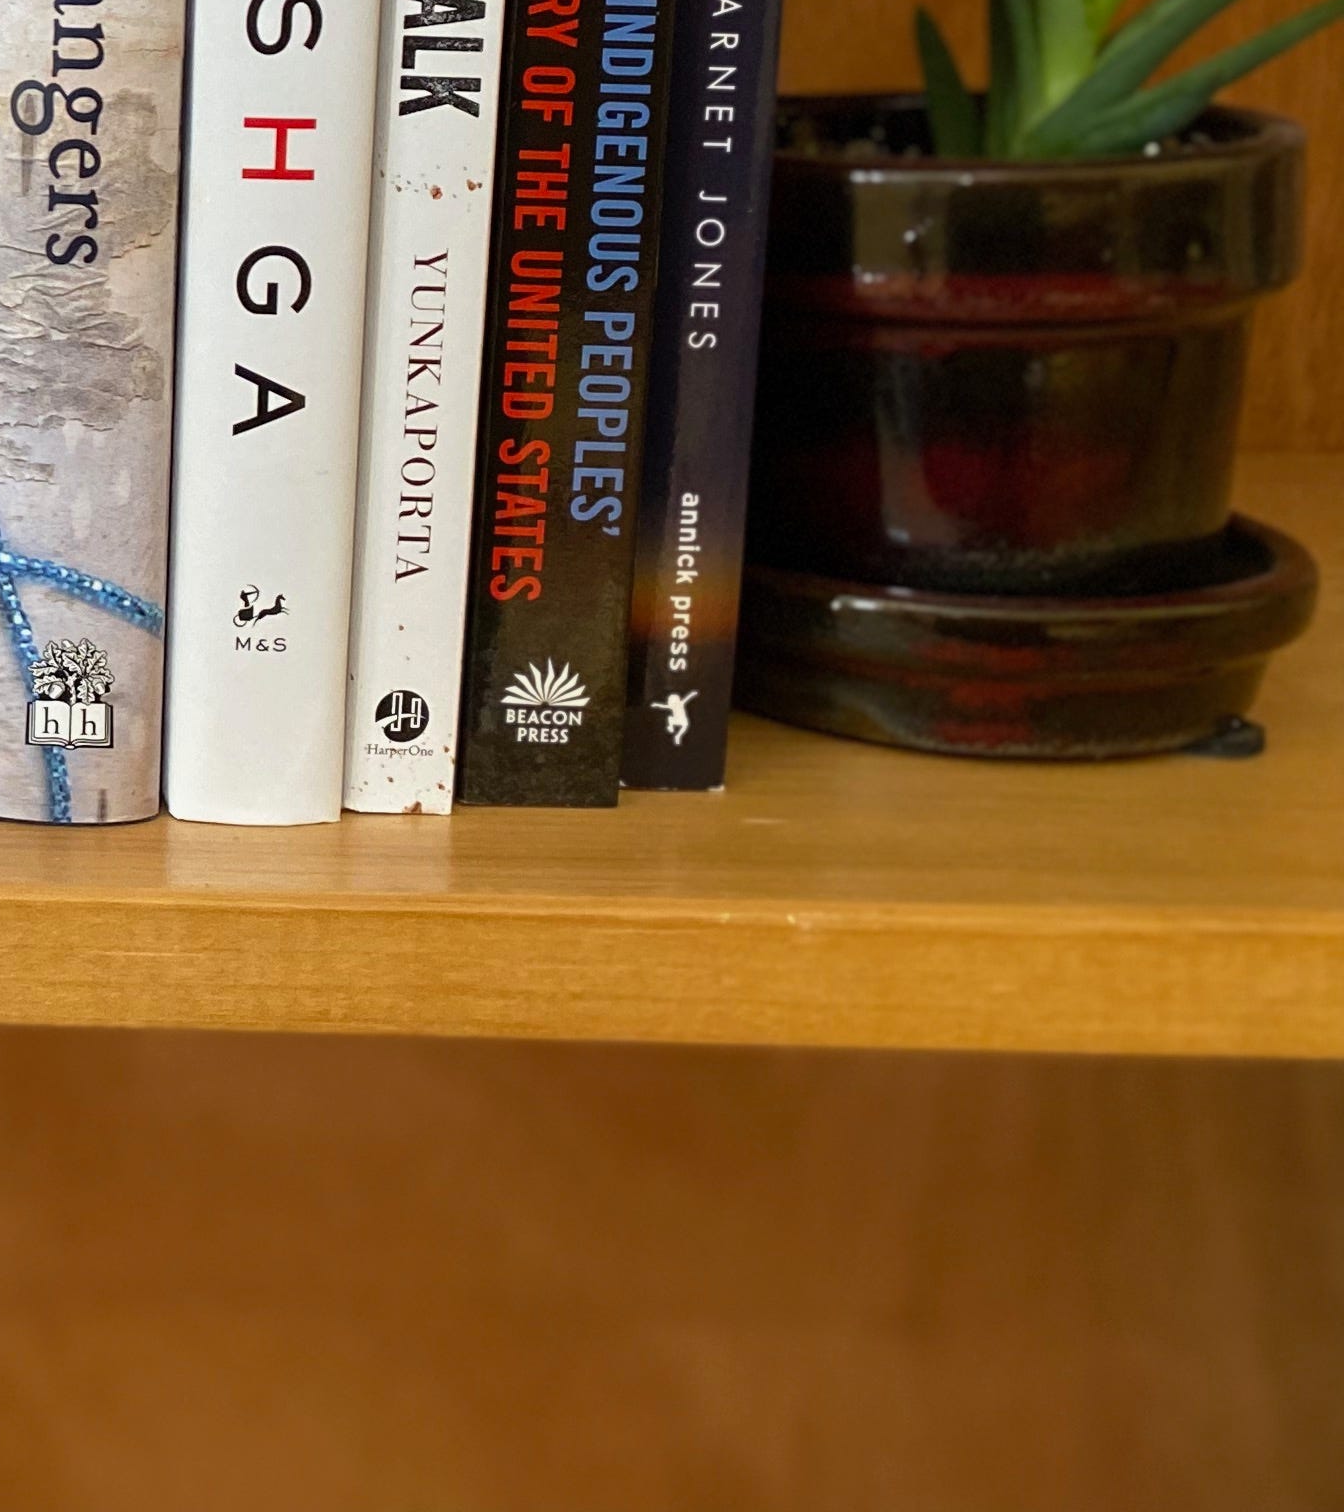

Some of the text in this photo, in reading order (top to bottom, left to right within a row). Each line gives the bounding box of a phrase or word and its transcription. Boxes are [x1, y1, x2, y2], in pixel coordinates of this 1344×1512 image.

[522, 66, 577, 125] OF
[513, 144, 570, 231] THE
[502, 250, 563, 420] UNITED
[688, 190, 728, 349] JONES
[394, 248, 449, 584] YUNKAPORTA
[570, 311, 636, 537] PEOPLES'
[490, 438, 551, 602] STATES
[667, 492, 700, 671] annick press
[366, 742, 434, 758] HarperOne
[505, 708, 582, 727] BEACON
[517, 727, 570, 744] PRESS
